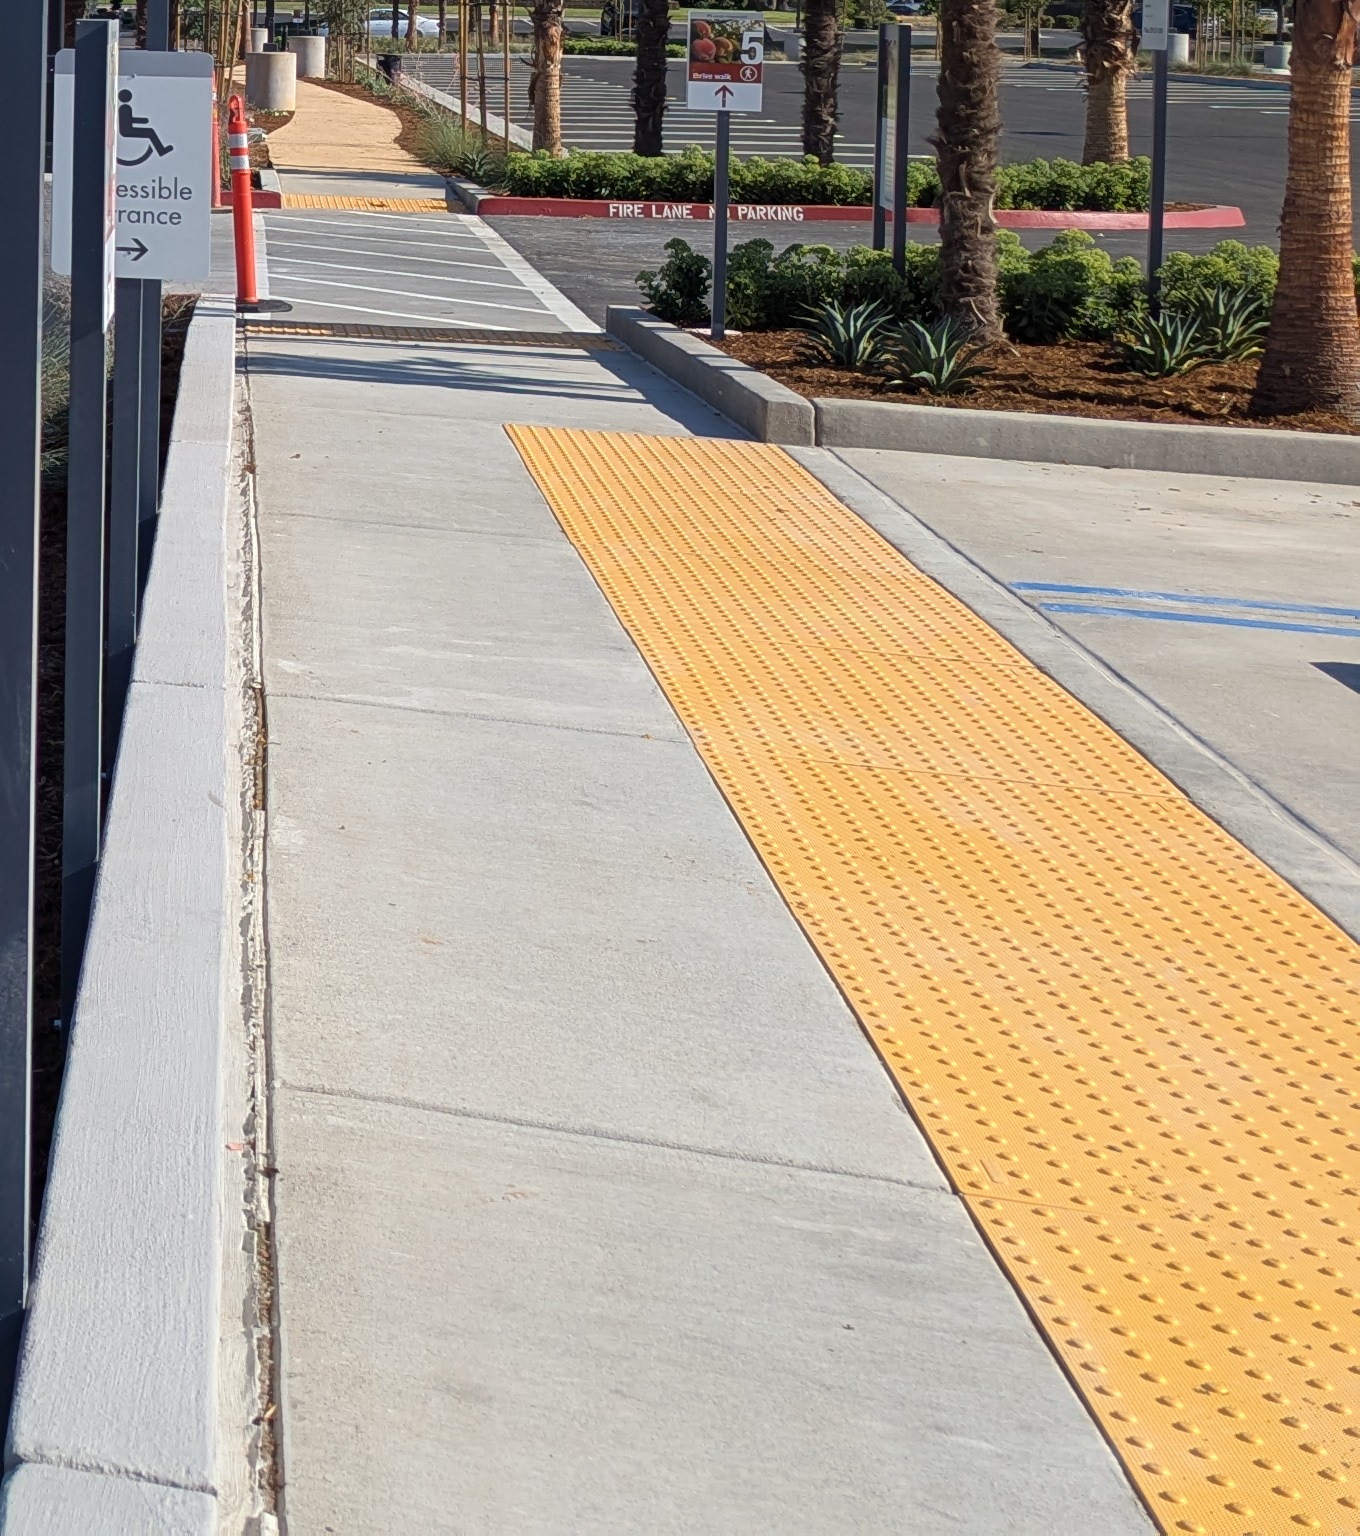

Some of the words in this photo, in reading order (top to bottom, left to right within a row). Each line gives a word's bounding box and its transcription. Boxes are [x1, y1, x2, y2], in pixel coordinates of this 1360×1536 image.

[740, 31, 764, 65] 5
[115, 176, 193, 201] essible
[115, 209, 182, 226] rance
[609, 203, 644, 218] FIRE
[652, 204, 693, 219] LANE
[737, 206, 804, 222] PARKING
